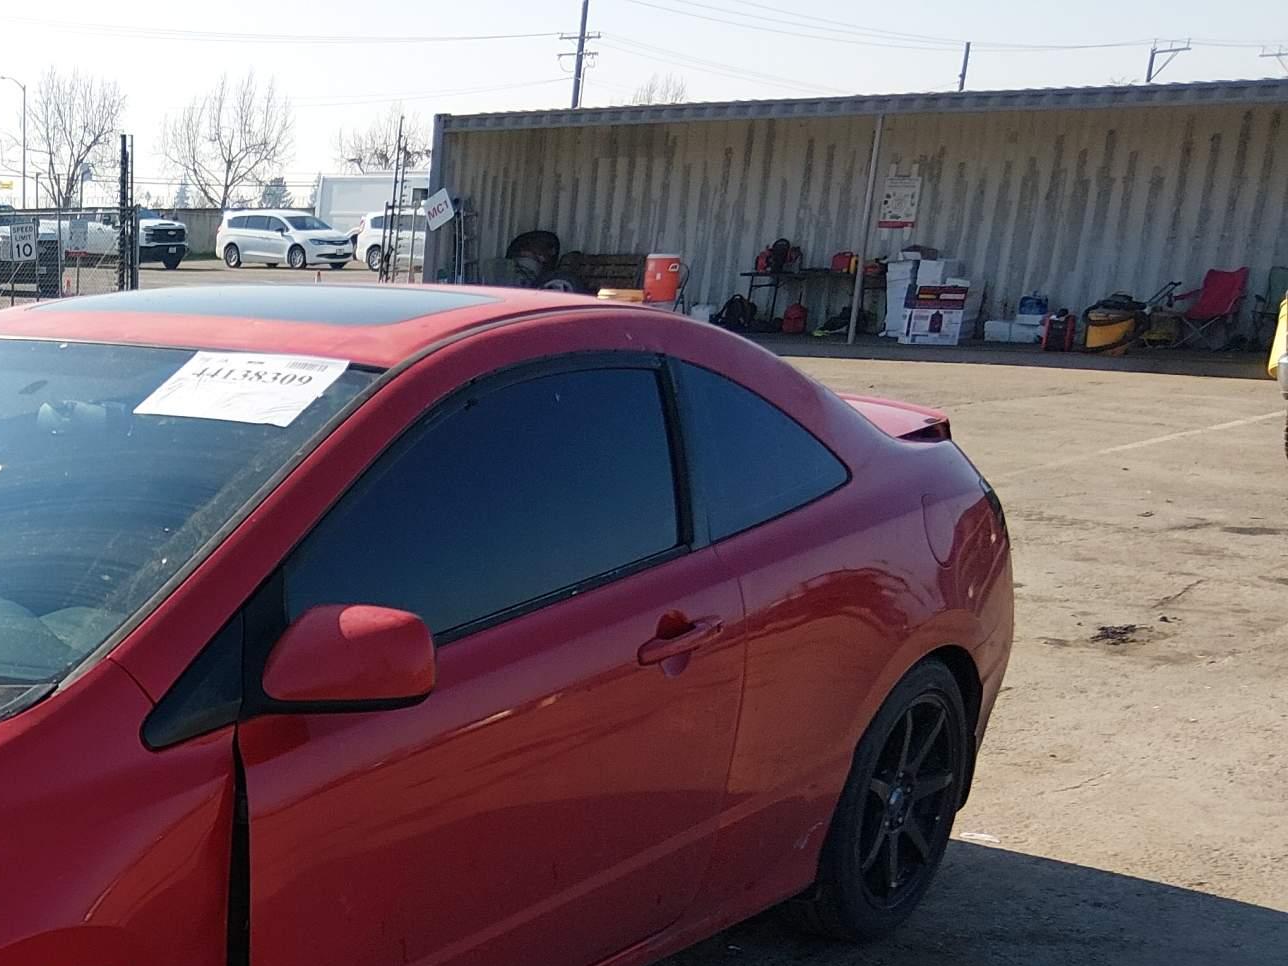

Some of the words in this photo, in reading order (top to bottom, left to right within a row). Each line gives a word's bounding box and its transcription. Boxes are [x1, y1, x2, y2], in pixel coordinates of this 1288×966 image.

[428, 200, 448, 220] MC1
[16, 243, 32, 258] 10
[192, 367, 313, 386] 44138309
